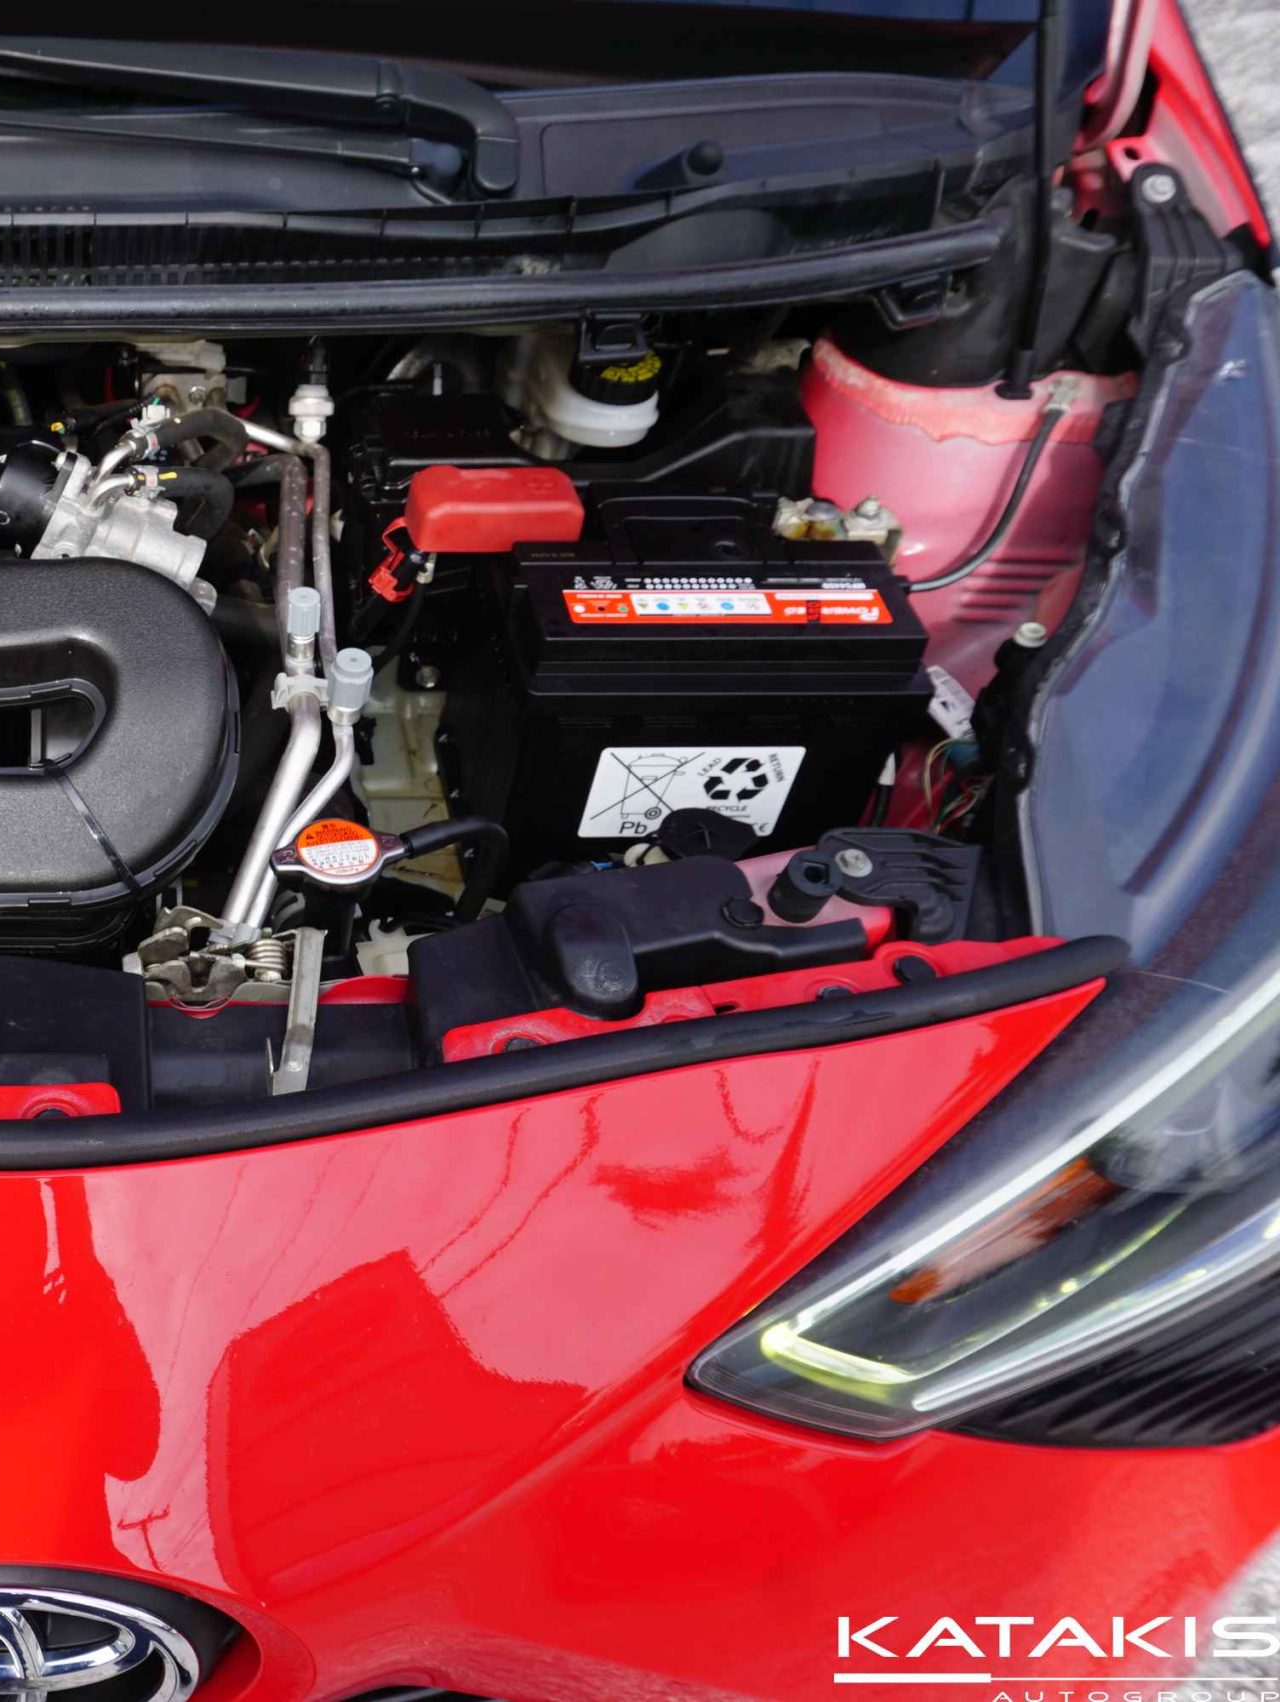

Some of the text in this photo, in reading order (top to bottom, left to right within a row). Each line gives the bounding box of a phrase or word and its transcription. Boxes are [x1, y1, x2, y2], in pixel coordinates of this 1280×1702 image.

[697, 757, 722, 777] LEAD
[768, 752, 785, 783] RETURN
[619, 821, 647, 835] Pb
